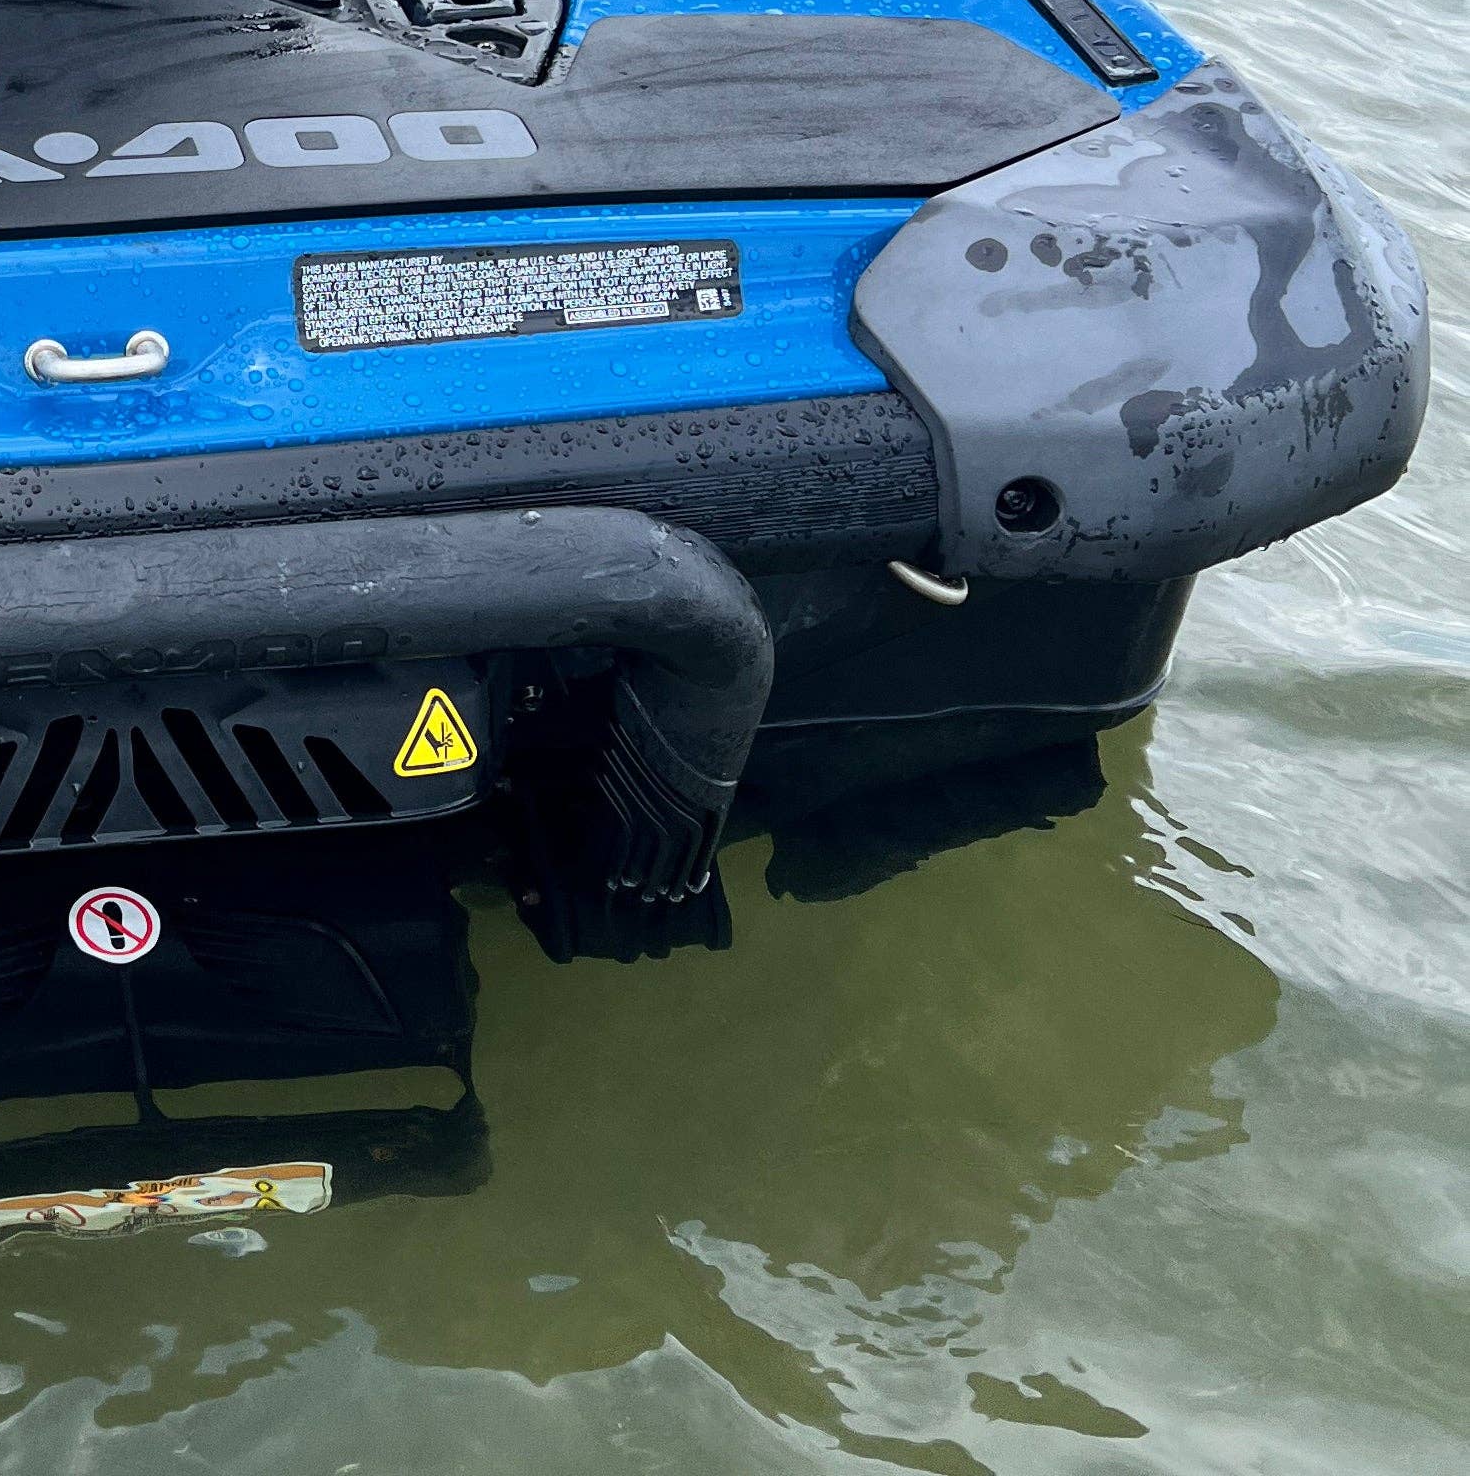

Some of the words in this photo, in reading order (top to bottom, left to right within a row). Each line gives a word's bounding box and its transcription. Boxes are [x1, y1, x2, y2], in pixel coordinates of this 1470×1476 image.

[301, 265, 321, 275] THIS
[323, 263, 346, 273] BOAT
[348, 262, 356, 271] IS
[358, 257, 429, 270] MANUFACTURED
[430, 255, 444, 265] BY
[302, 283, 332, 294] GRANT
[334, 281, 346, 291] OF
[456, 271, 474, 281] THE
[474, 269, 505, 280] COAST
[507, 266, 538, 277] GUARD
[584, 261, 603, 271] THIS
[604, 258, 636, 270] VESSEL
[639, 255, 666, 267] FROM
[666, 254, 684, 265] ONE
[686, 253, 700, 263] OR
[701, 250, 726, 262] MORE
[428, 262, 477, 275] PRODUCTS
[498, 259, 516, 269] PER
[578, 252, 597, 263] AND
[617, 248, 647, 260] COAST
[648, 245, 680, 257] GUARD
[303, 292, 338, 303] SAFETY
[452, 280, 485, 291] STATES
[486, 278, 509, 289] THAT
[510, 275, 548, 287] CERTAIN
[611, 268, 630, 279] ARE
[692, 263, 702, 272] IN
[703, 260, 728, 271] LIGHT
[303, 302, 316, 312] OF
[318, 301, 337, 311] THIS
[463, 289, 482, 299] AND
[484, 287, 505, 298] THAT
[508, 285, 526, 296] THE
[600, 278, 620, 288] NOT
[620, 276, 644, 287] HAVE
[645, 275, 658, 285] AN
[659, 271, 699, 284] ADVERSE
[700, 268, 733, 280] EFFECT
[304, 311, 318, 321] ON
[318, 306, 383, 320] RECREATIONAL
[386, 303, 424, 315] BOATING
[463, 298, 482, 309] THIS
[484, 296, 508, 307] BOAT
[556, 291, 578, 302] WITH
[598, 287, 628, 298] COAST
[630, 284, 660, 296] GUARD
[662, 281, 696, 294] SAFETY
[304, 318, 357, 331] STANDARDS
[359, 317, 368, 327] IN
[369, 314, 403, 326] EFFECT
[404, 313, 418, 323] ON
[419, 311, 438, 322] THE
[439, 309, 462, 320] DATE
[463, 308, 476, 318] OF
[547, 301, 564, 312] ALL
[564, 297, 606, 310] PERSONS
[608, 294, 644, 307] SHOULD
[646, 292, 670, 304] WEAR
[671, 291, 680, 302] A
[569, 307, 620, 321] ASSEMBLED
[622, 307, 631, 317] IN
[632, 304, 666, 316] MEXICO
[495, 313, 524, 325] WHILE
[318, 335, 369, 348] OPERATING
[370, 333, 384, 344] OR
[418, 329, 432, 340] ON
[433, 327, 454, 339] THIS
